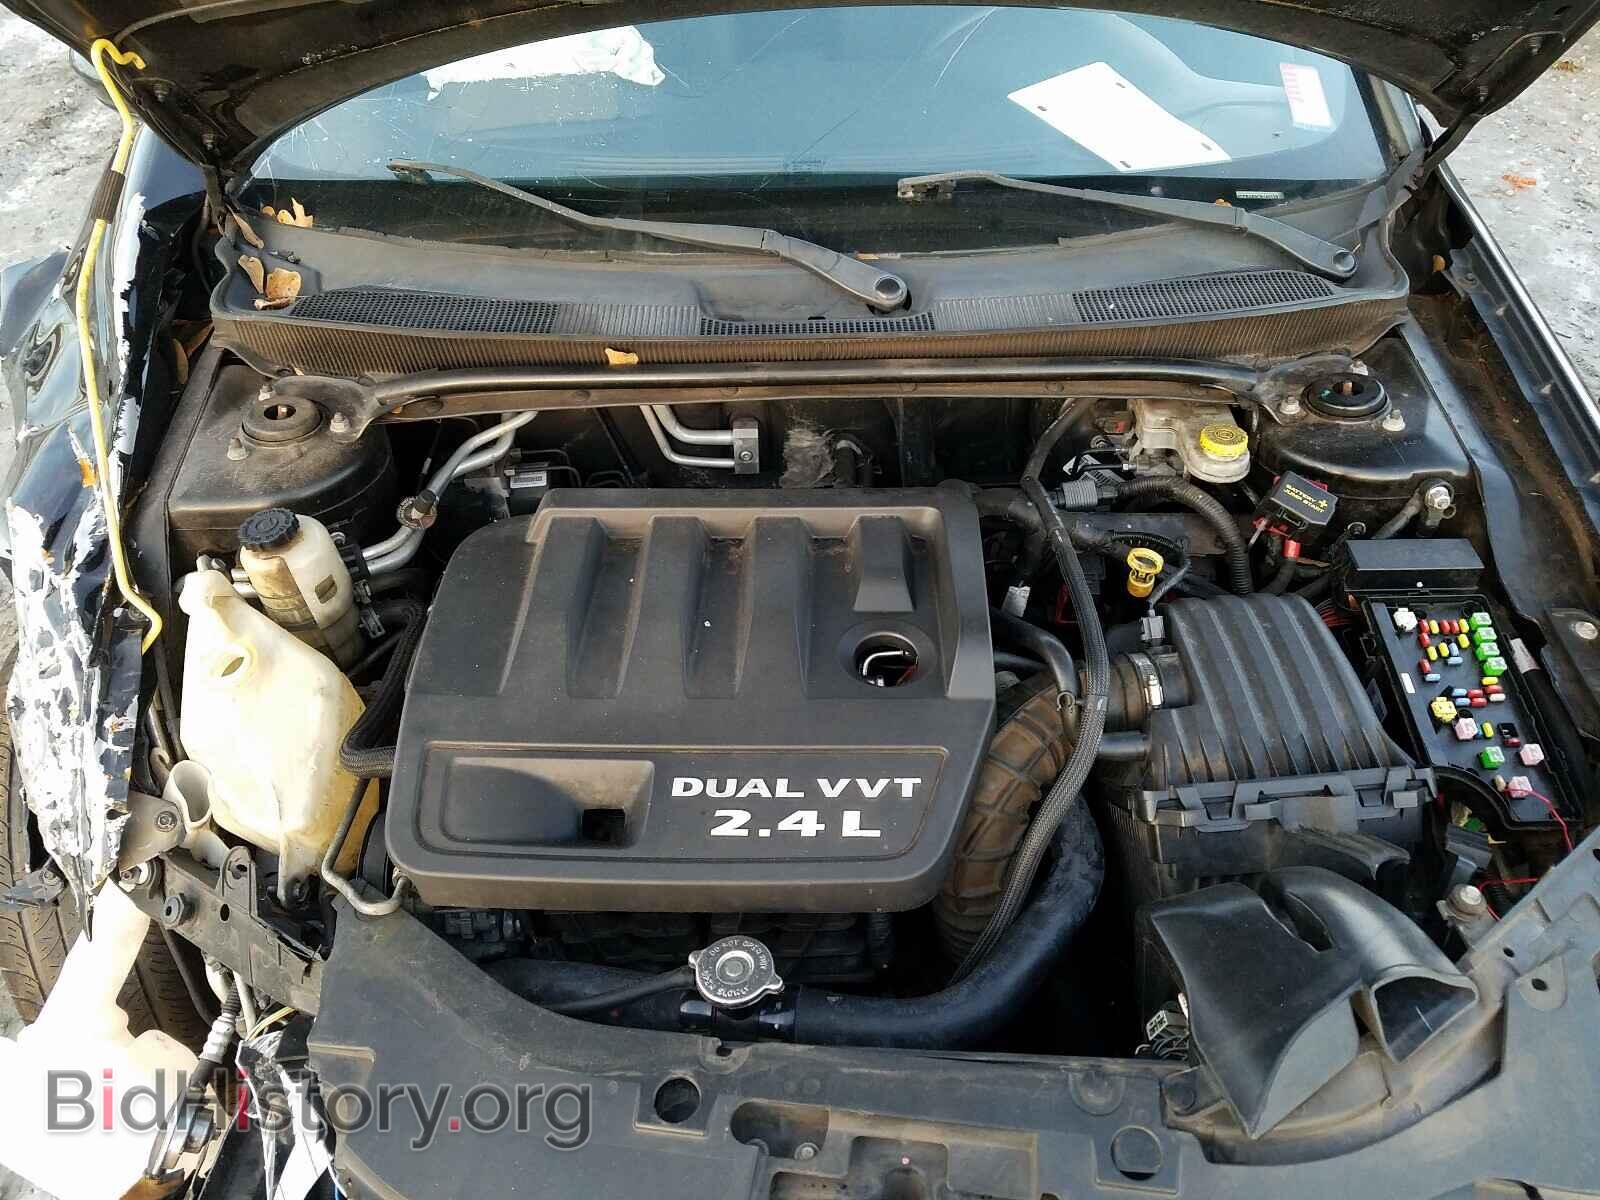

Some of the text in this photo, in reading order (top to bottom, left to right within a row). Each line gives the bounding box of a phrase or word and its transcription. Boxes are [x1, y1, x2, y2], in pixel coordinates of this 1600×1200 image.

[1286, 483, 1316, 503] BATTERY
[1302, 499, 1325, 513] START
[671, 777, 922, 798] DUAL VVT
